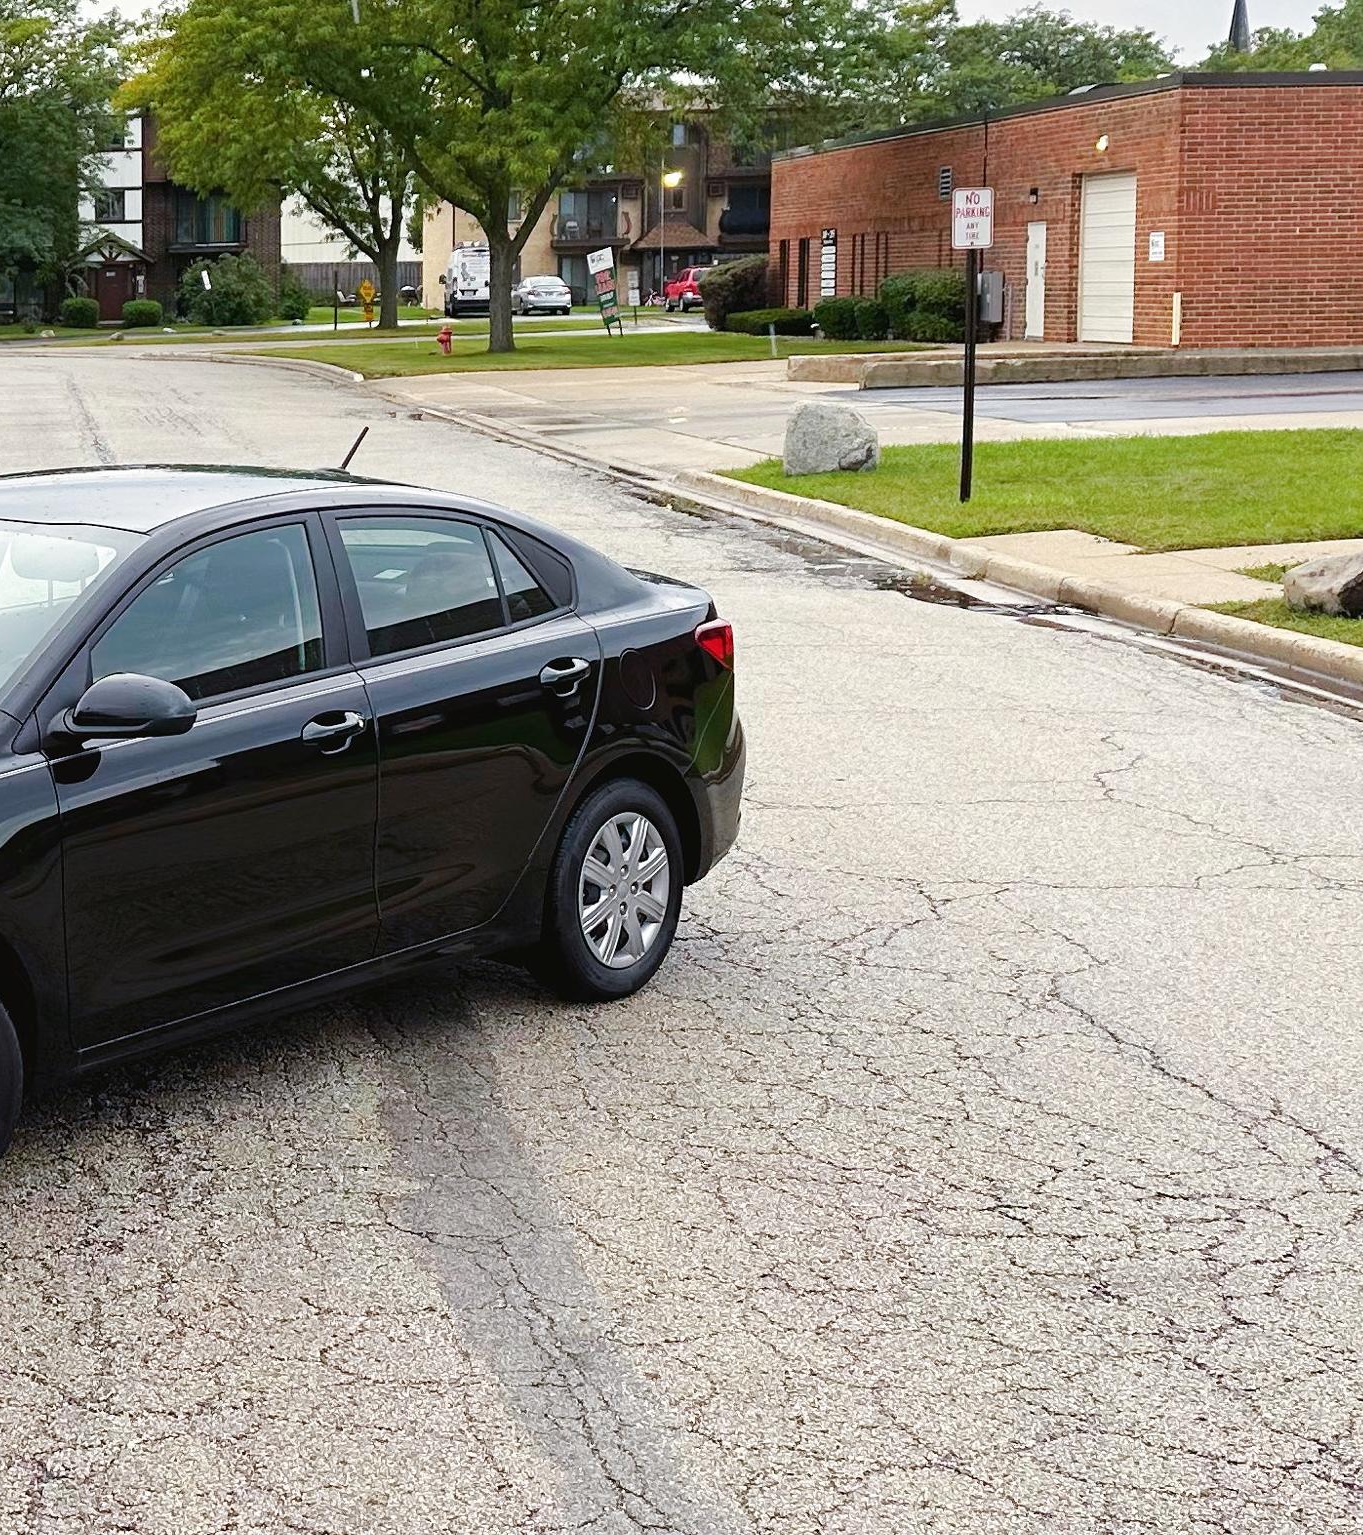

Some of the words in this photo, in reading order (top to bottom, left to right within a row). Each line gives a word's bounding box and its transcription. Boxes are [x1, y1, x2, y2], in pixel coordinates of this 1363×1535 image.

[965, 193, 980, 205] NO
[956, 206, 990, 218] PARKING
[966, 222, 979, 230] ANY
